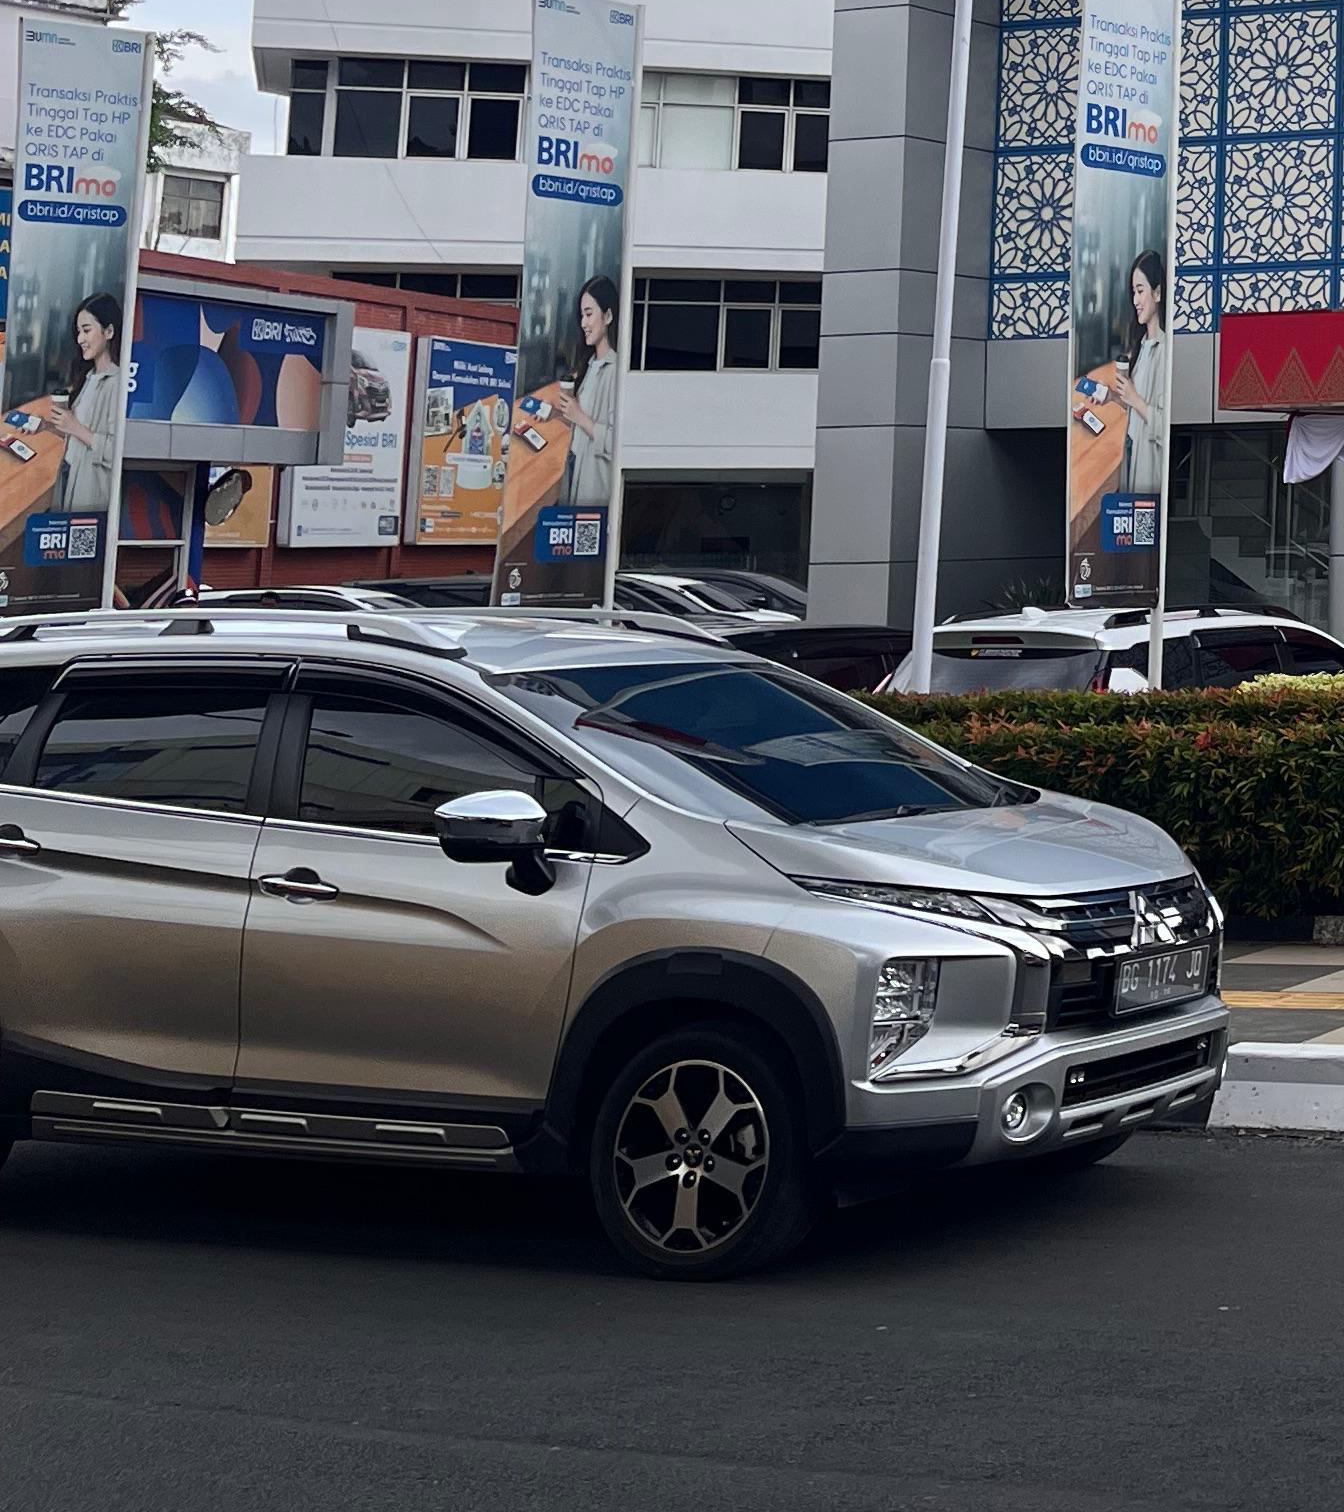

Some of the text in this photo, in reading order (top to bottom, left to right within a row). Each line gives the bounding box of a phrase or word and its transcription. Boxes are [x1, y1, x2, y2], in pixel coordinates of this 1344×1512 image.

[1091, 14, 1171, 46] Transaksi Praktis
[1089, 36, 1167, 64] Tinggal Tap HP
[541, 51, 631, 81] Transaksi Praktis
[1088, 59, 1157, 85] ke EDC Pakai
[27, 82, 138, 107] Transaksi Praktis
[540, 72, 625, 100] Tinggal Tap HP
[1086, 80, 1148, 104] QRIS TAP di
[27, 103, 131, 124] Tinggal Tap HP
[539, 95, 614, 118] ke EDC Pakai
[26, 123, 117, 143] ke EDC Pakai
[538, 114, 603, 137] QRIS TAP di
[25, 142, 104, 161] QRIS TAP di
[264, 322, 283, 341] BRI
[345, 430, 397, 450] Spesial BRI
[549, 528, 573, 544] BRI
[1113, 517, 1132, 534] BRI
[40, 533, 67, 549] BRI
[1121, 963, 1140, 993] BG
[1148, 954, 1178, 988] 1174
